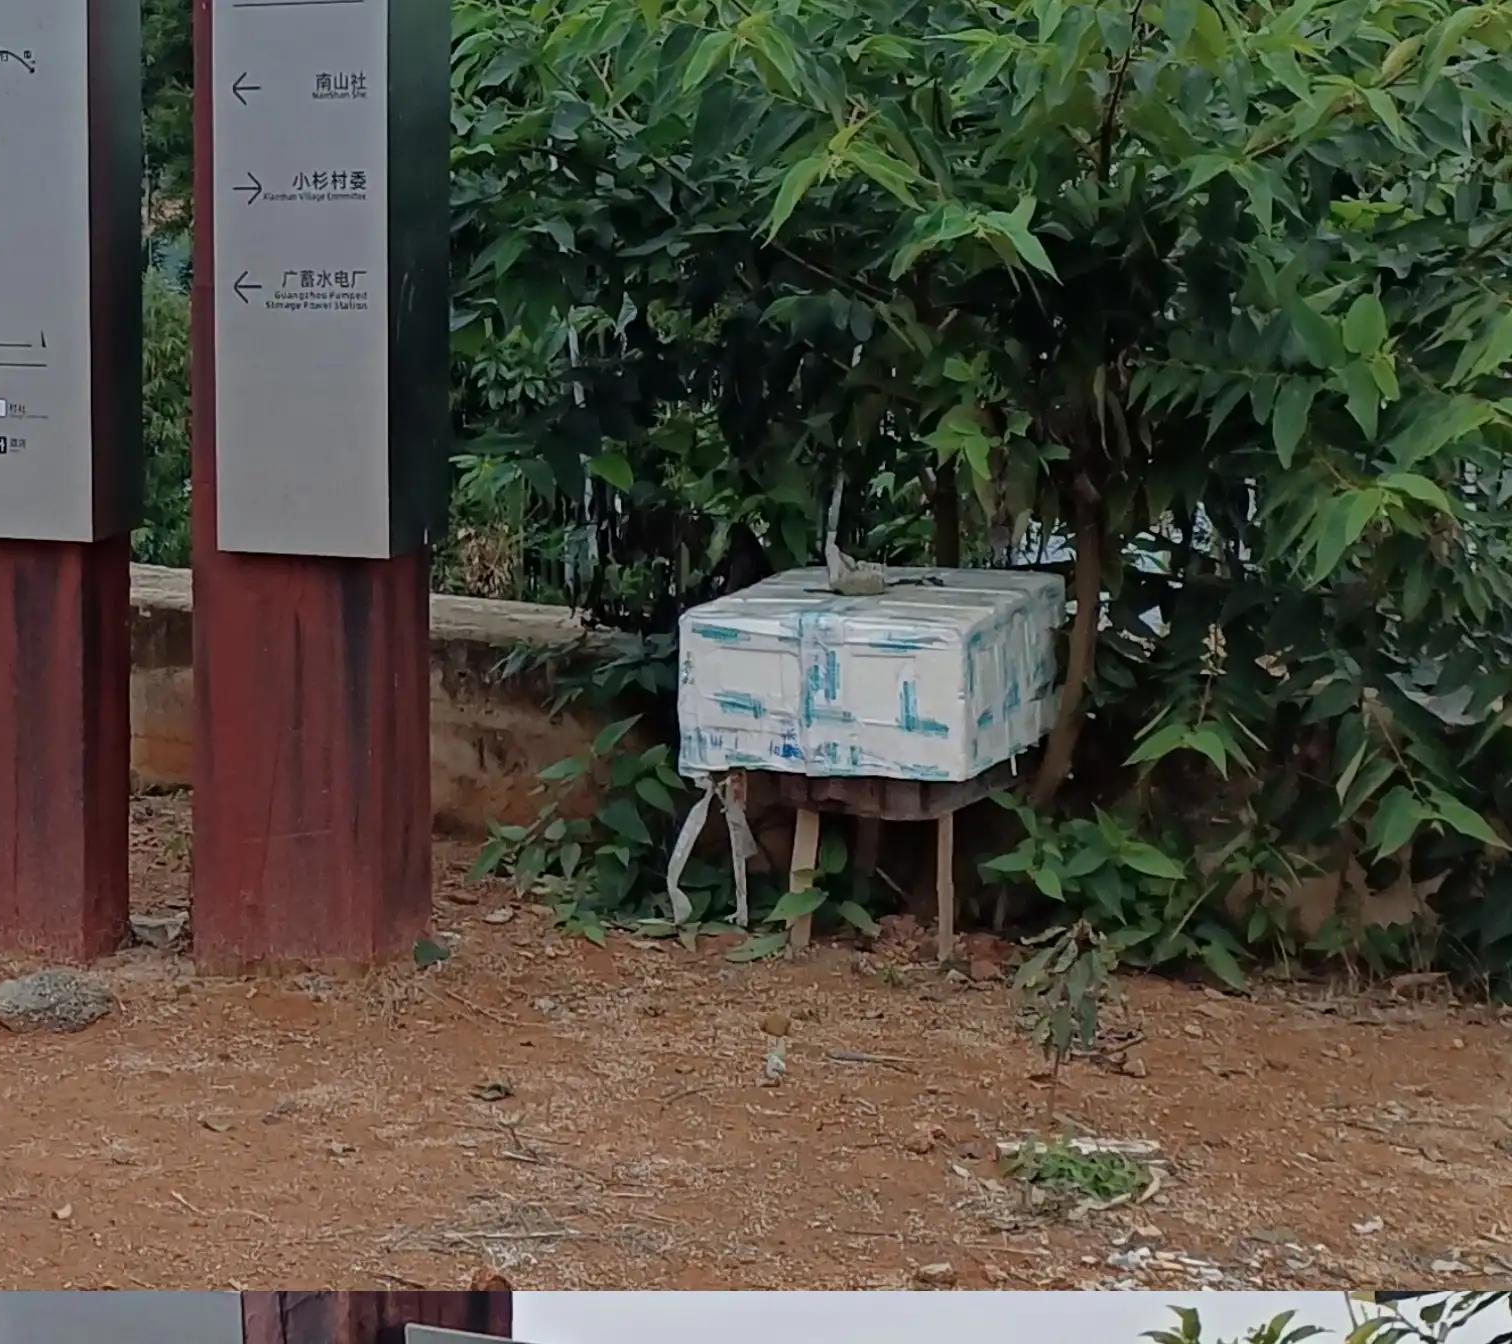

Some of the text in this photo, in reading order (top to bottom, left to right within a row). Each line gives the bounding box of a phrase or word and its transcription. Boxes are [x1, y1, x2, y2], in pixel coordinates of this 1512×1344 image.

[316, 70, 367, 93] 南山社
[292, 170, 367, 190] 小杉村委
[282, 270, 367, 288] 广蓄水电厂
